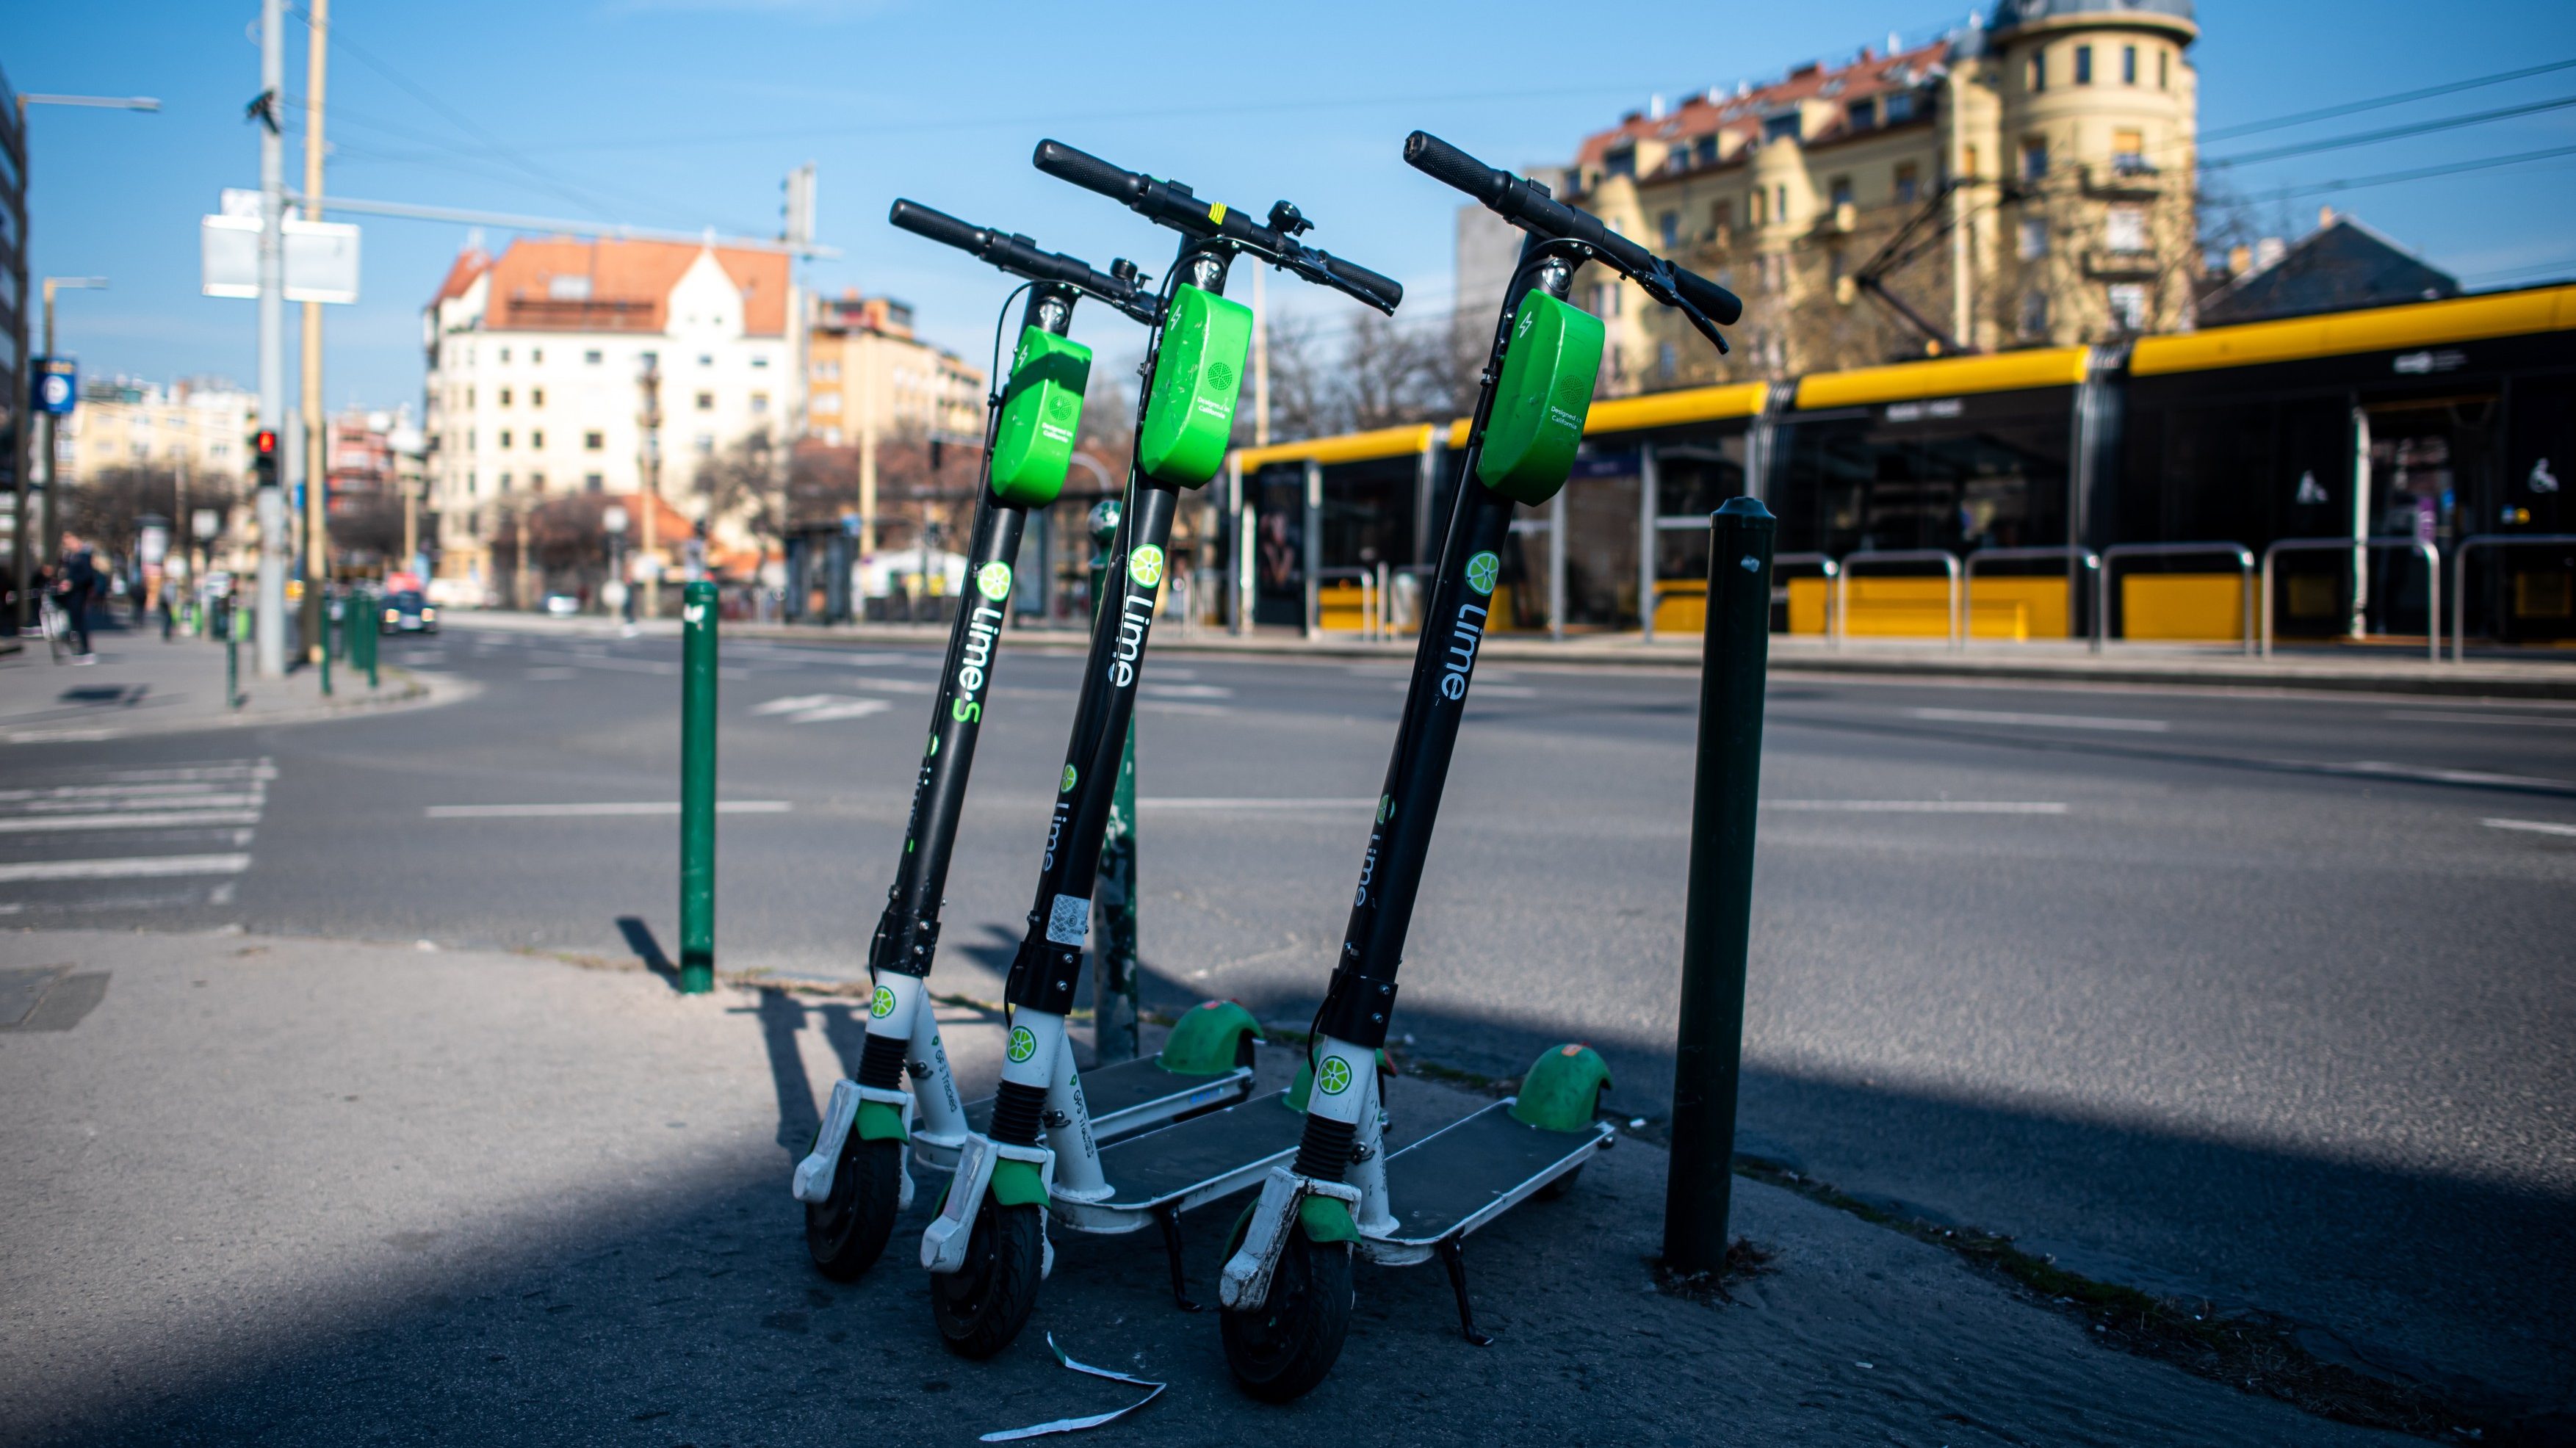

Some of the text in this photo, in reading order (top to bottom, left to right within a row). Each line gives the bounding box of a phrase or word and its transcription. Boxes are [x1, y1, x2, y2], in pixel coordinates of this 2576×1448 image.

[1198, 405, 1225, 419] California
[1551, 405, 1576, 421] Designed
[1551, 415, 1577, 430] California
[1108, 595, 1153, 687] Lime
[1441, 604, 1487, 701] Lime
[1043, 803, 1069, 872] Lime
[1355, 833, 1381, 907] Lime
[1074, 1090, 1084, 1115] GPS
